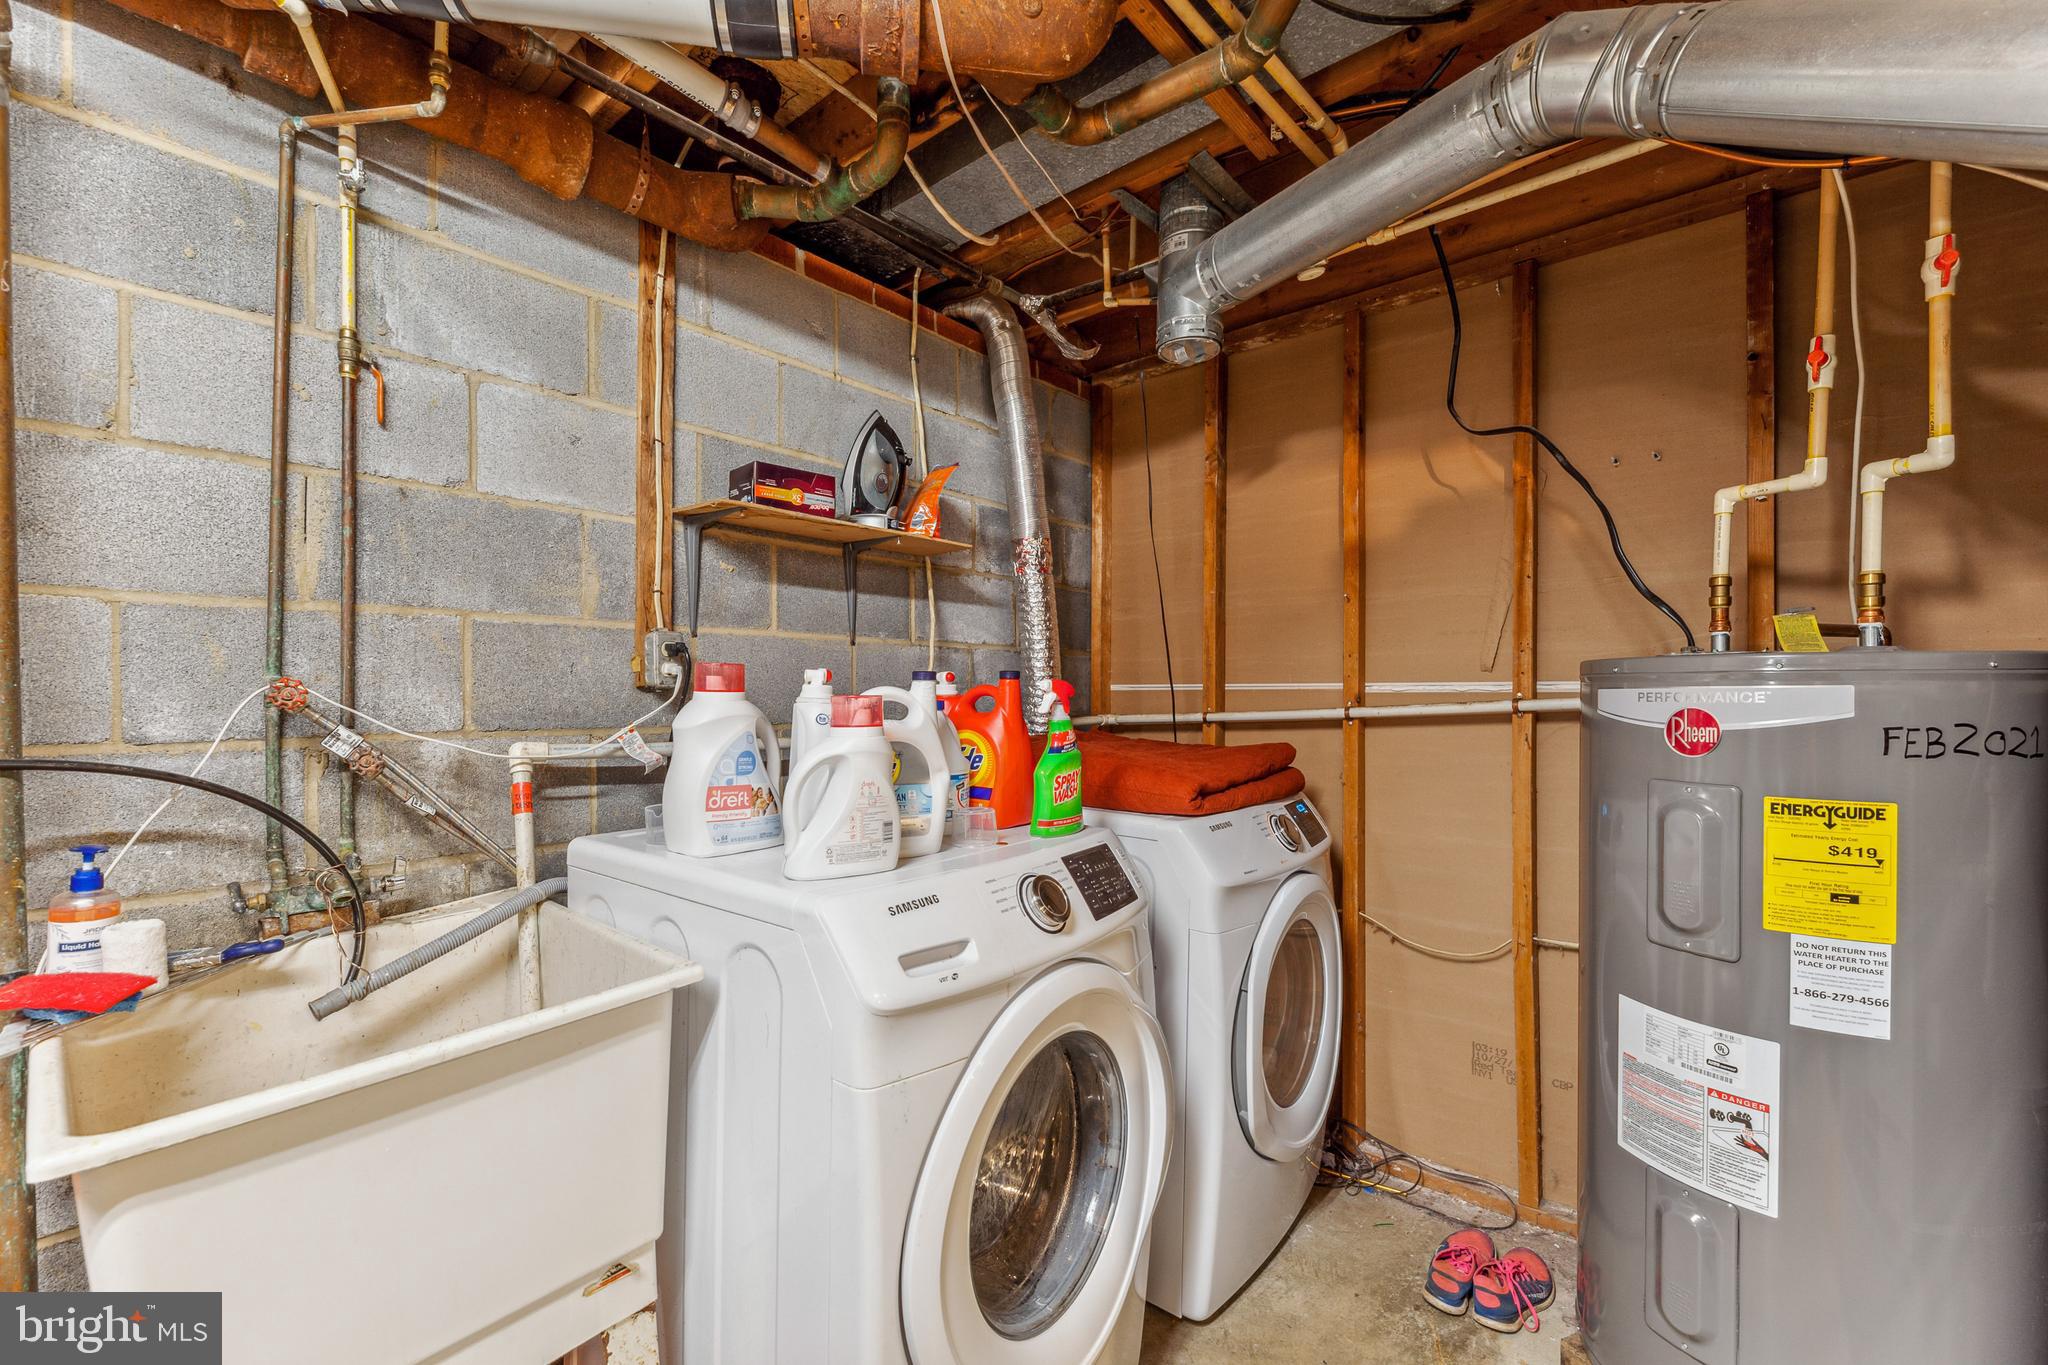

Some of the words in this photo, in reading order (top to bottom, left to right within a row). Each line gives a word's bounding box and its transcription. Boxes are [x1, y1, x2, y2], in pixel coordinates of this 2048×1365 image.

[1671, 708, 1718, 749] Rheem
[1883, 727, 1946, 759] FEB
[1953, 722, 2046, 759] 2021
[1054, 768, 1081, 791] SPRAY
[709, 789, 750, 808] dreft
[1053, 783, 1079, 805] WASH
[1770, 802, 1887, 821] ENERGYGUIDE
[1208, 820, 1233, 833] SAMSUNG
[1828, 845, 1878, 859] $419
[888, 894, 940, 916] SAMSUNG
[61, 943, 87, 951] Liquid
[1796, 941, 1809, 949] DO
[1811, 944, 1829, 952] NOT
[1831, 946, 1866, 956] RETURN
[1793, 950, 1823, 960] WATER
[1825, 954, 1857, 964] HEATER
[1859, 958, 1871, 966] TO
[1874, 960, 1889, 968] THE
[1797, 959, 1824, 969] PLACE
[1840, 965, 1885, 976] PURCHASE
[1792, 986, 1890, 1008] 1-866-279-4566
[1475, 1042, 1508, 1057] 03:19
[1721, 1093, 1766, 1112] DANGER
